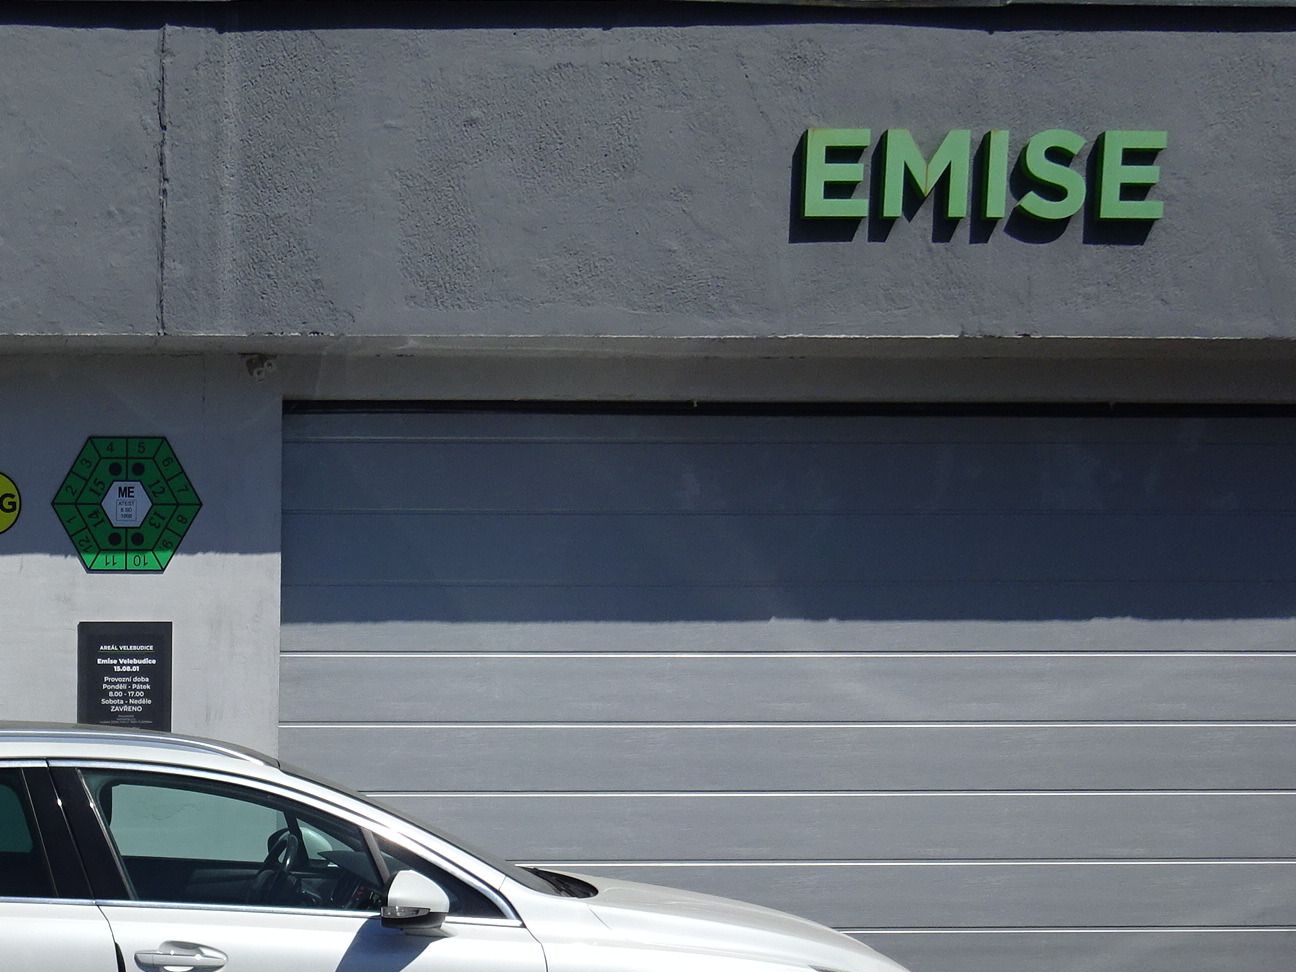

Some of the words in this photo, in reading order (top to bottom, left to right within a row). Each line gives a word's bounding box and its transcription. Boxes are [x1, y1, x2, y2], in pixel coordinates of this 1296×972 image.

[803, 127, 1169, 221] EMISE
[106, 441, 115, 452] 4
[137, 441, 146, 453] 5
[81, 458, 93, 468] 3
[65, 485, 77, 496] 2
[118, 486, 135, 499] ME
[105, 556, 117, 566] 11
[133, 556, 149, 566] 10
